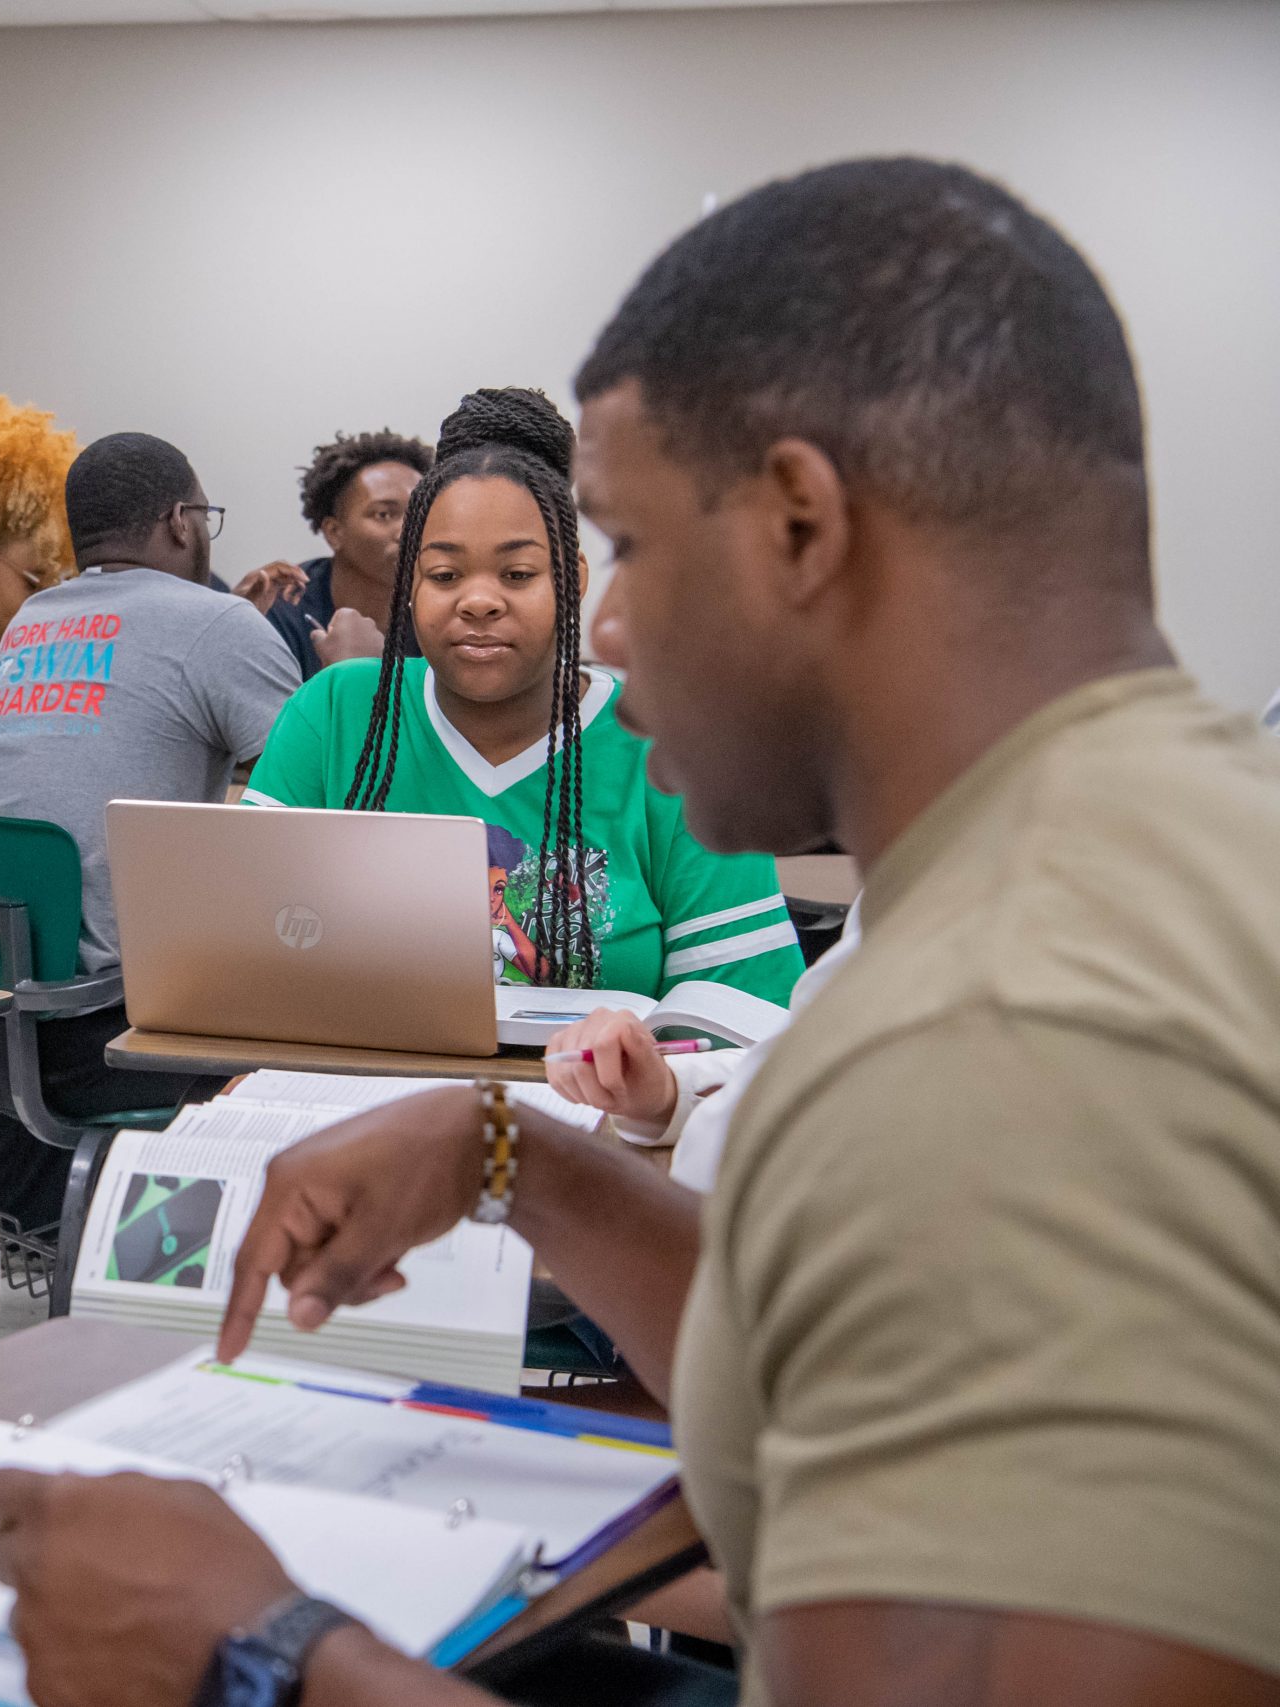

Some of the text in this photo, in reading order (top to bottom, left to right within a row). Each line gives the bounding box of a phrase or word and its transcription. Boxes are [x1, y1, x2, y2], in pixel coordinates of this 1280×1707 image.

[55, 613, 122, 641] HARD
[9, 641, 115, 683] SWIM
[276, 905, 321, 949] hp
